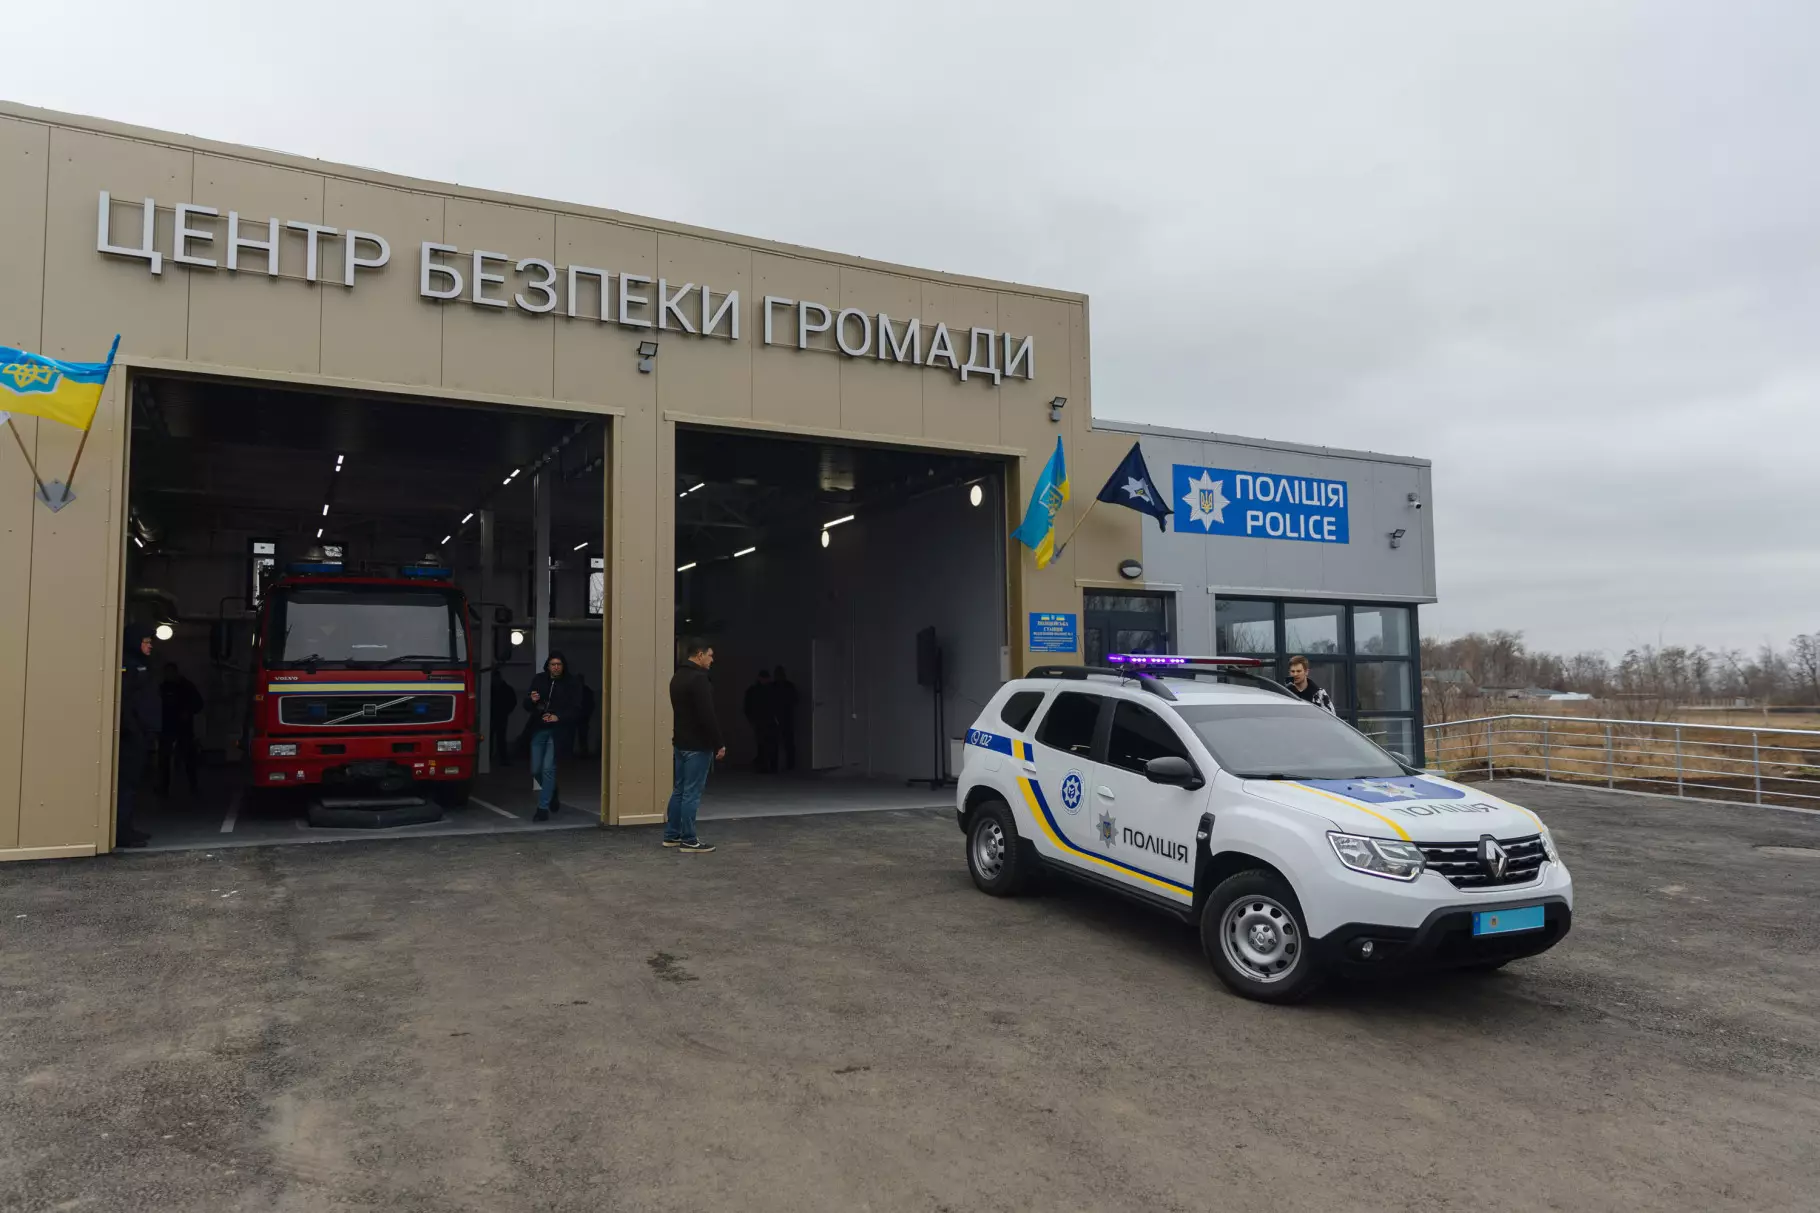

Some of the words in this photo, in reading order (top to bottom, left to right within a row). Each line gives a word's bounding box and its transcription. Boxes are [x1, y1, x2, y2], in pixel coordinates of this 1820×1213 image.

[97, 190, 391, 288] ЦЕНТР
[420, 240, 741, 340] БЕЗПЕКИ
[763, 295, 1034, 385] ГРОМАДИ
[1235, 474, 1344, 508] ПОЛІЦІЯ
[1246, 510, 1337, 540] POLICE
[980, 733, 993, 747] 102
[1390, 802, 1499, 818] ПОЛІЦІЯ
[1123, 827, 1188, 863] ПОЛІЦІЯ
